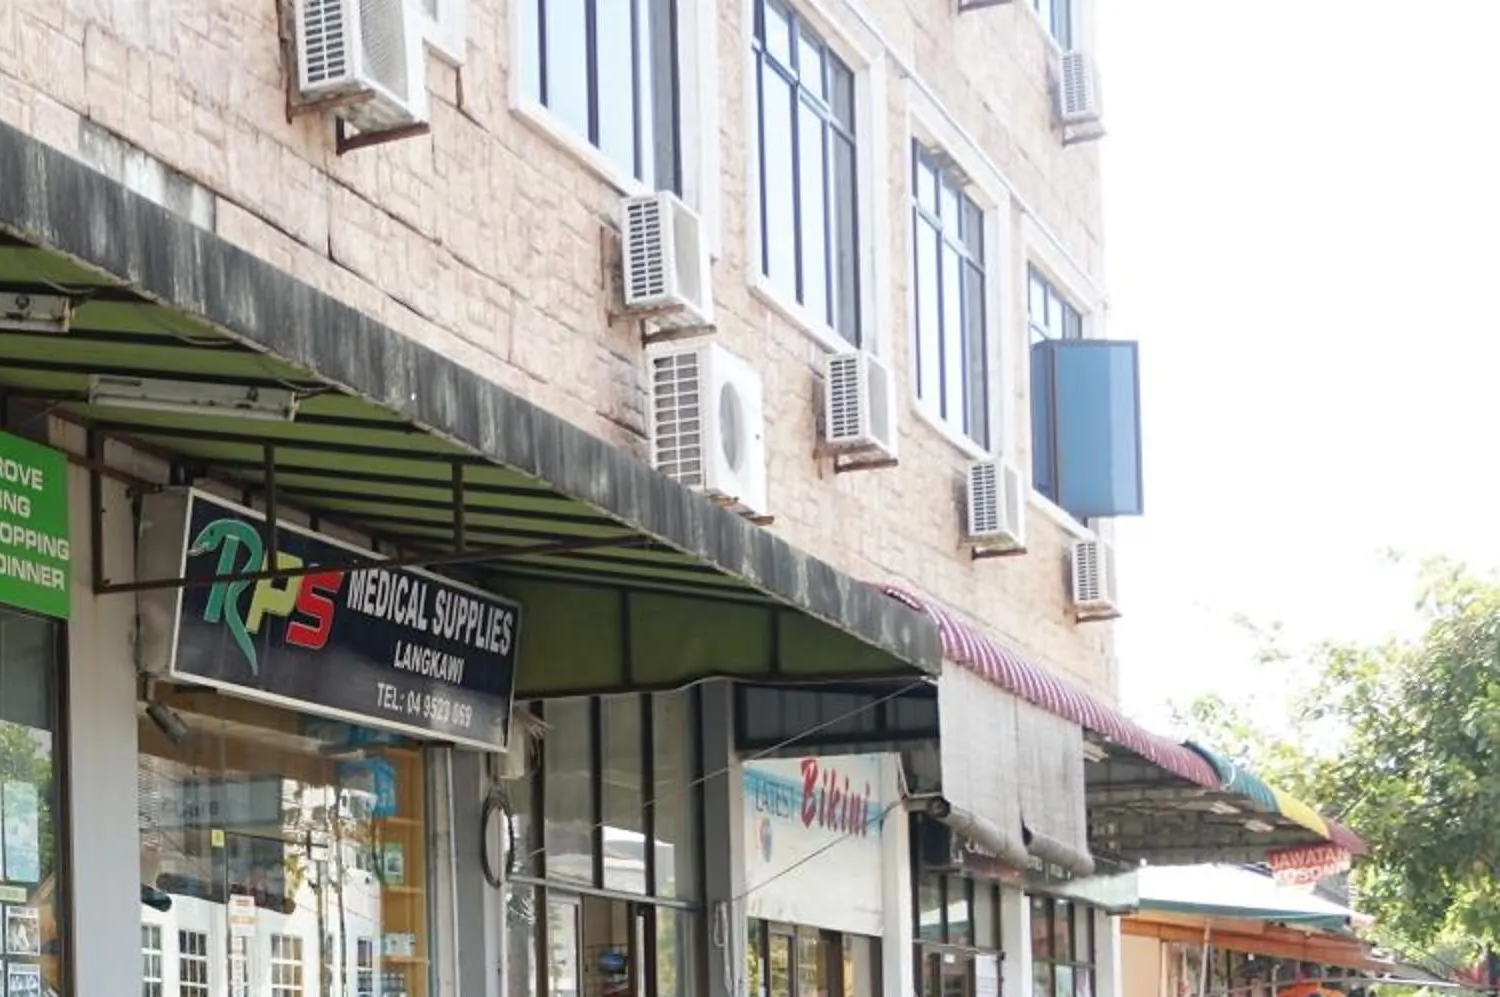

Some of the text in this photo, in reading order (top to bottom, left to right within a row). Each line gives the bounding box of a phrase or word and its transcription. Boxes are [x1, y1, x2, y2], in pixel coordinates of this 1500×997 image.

[346, 567, 514, 657] MEDICAL SUPPLIES
[393, 639, 466, 685] LANGKAWI
[377, 681, 404, 713] TEL:
[407, 689, 422, 716] 04
[754, 757, 871, 840] LATEST Bikini
